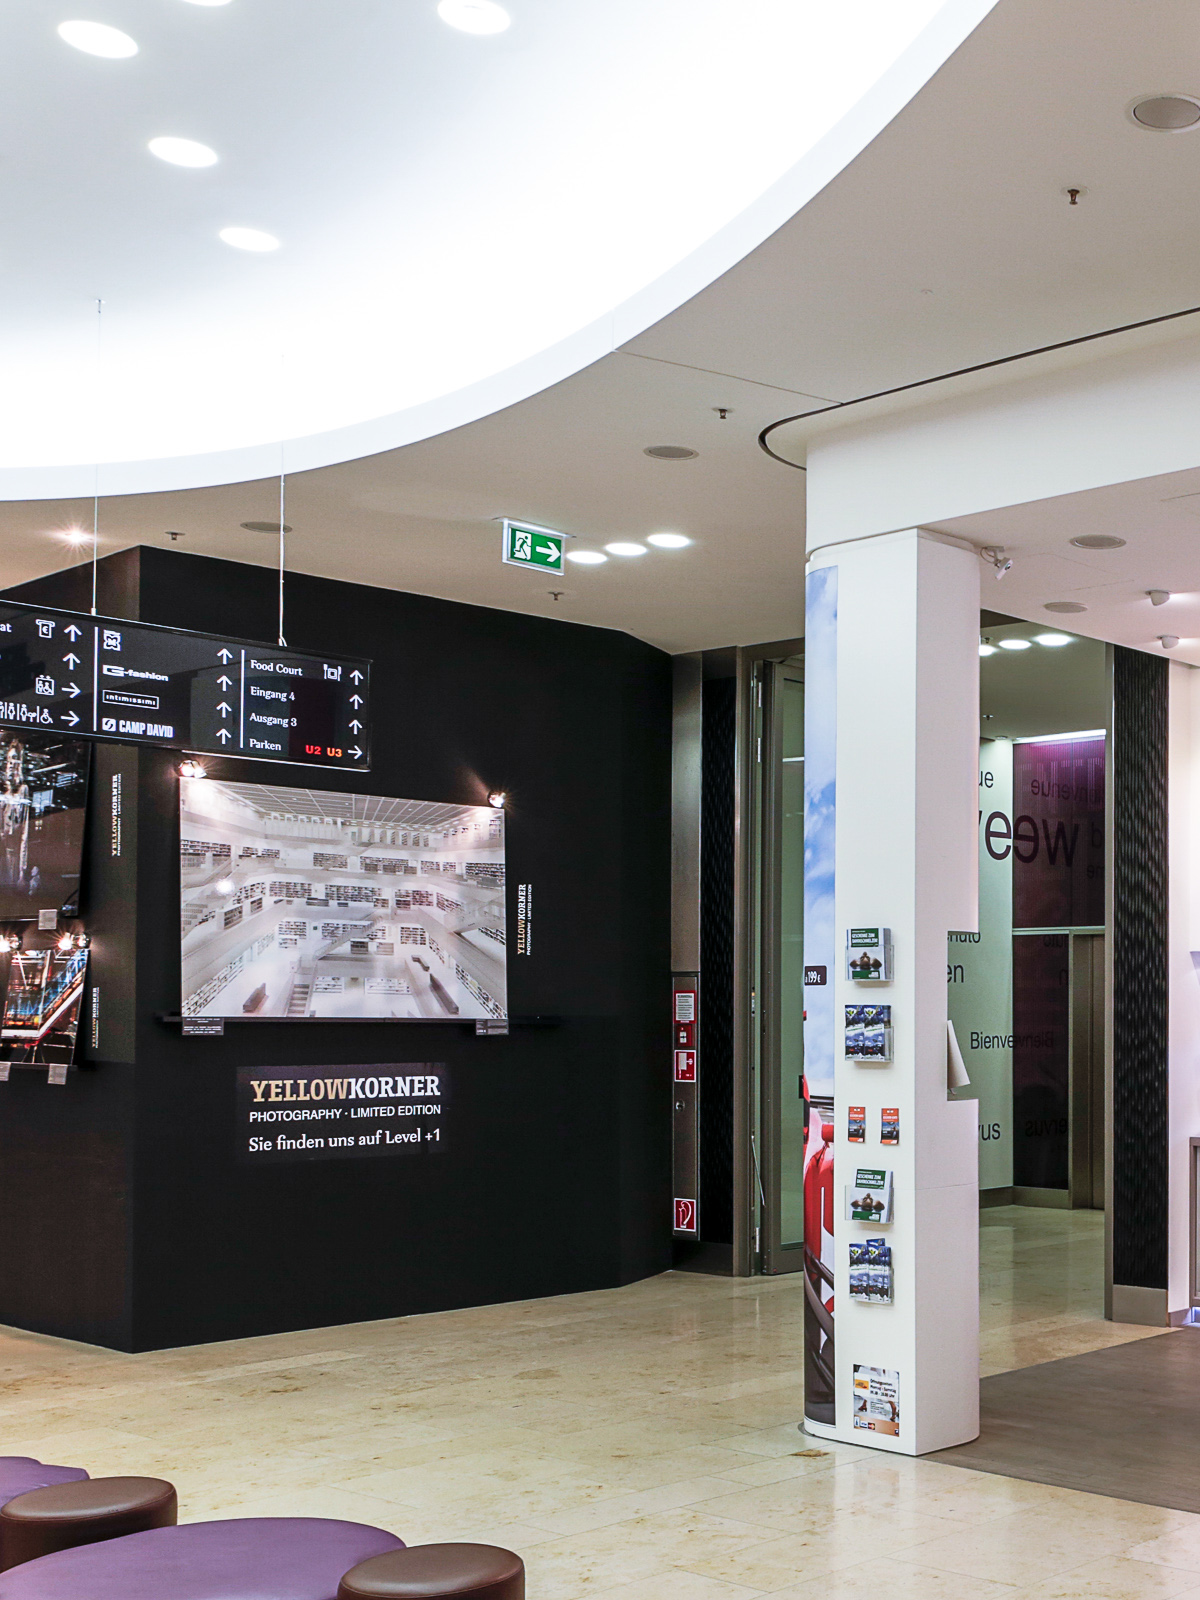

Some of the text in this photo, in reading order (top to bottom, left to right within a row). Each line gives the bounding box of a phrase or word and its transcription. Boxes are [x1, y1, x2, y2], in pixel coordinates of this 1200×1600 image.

[250, 659, 303, 676] Food Court
[250, 685, 296, 702] Eingang 4
[119, 719, 174, 738] CAMP DAVID
[249, 712, 297, 728] Ausgang 3
[249, 738, 342, 758] Parken U2 U3
[517, 883, 526, 955] YELLOWKORNER
[250, 1075, 441, 1103] YELLOWKORNER
[249, 1104, 441, 1123] PHOTOGRAPHY LIMITED EDITION
[249, 1127, 441, 1152] Sie finden uns auf Level +1
